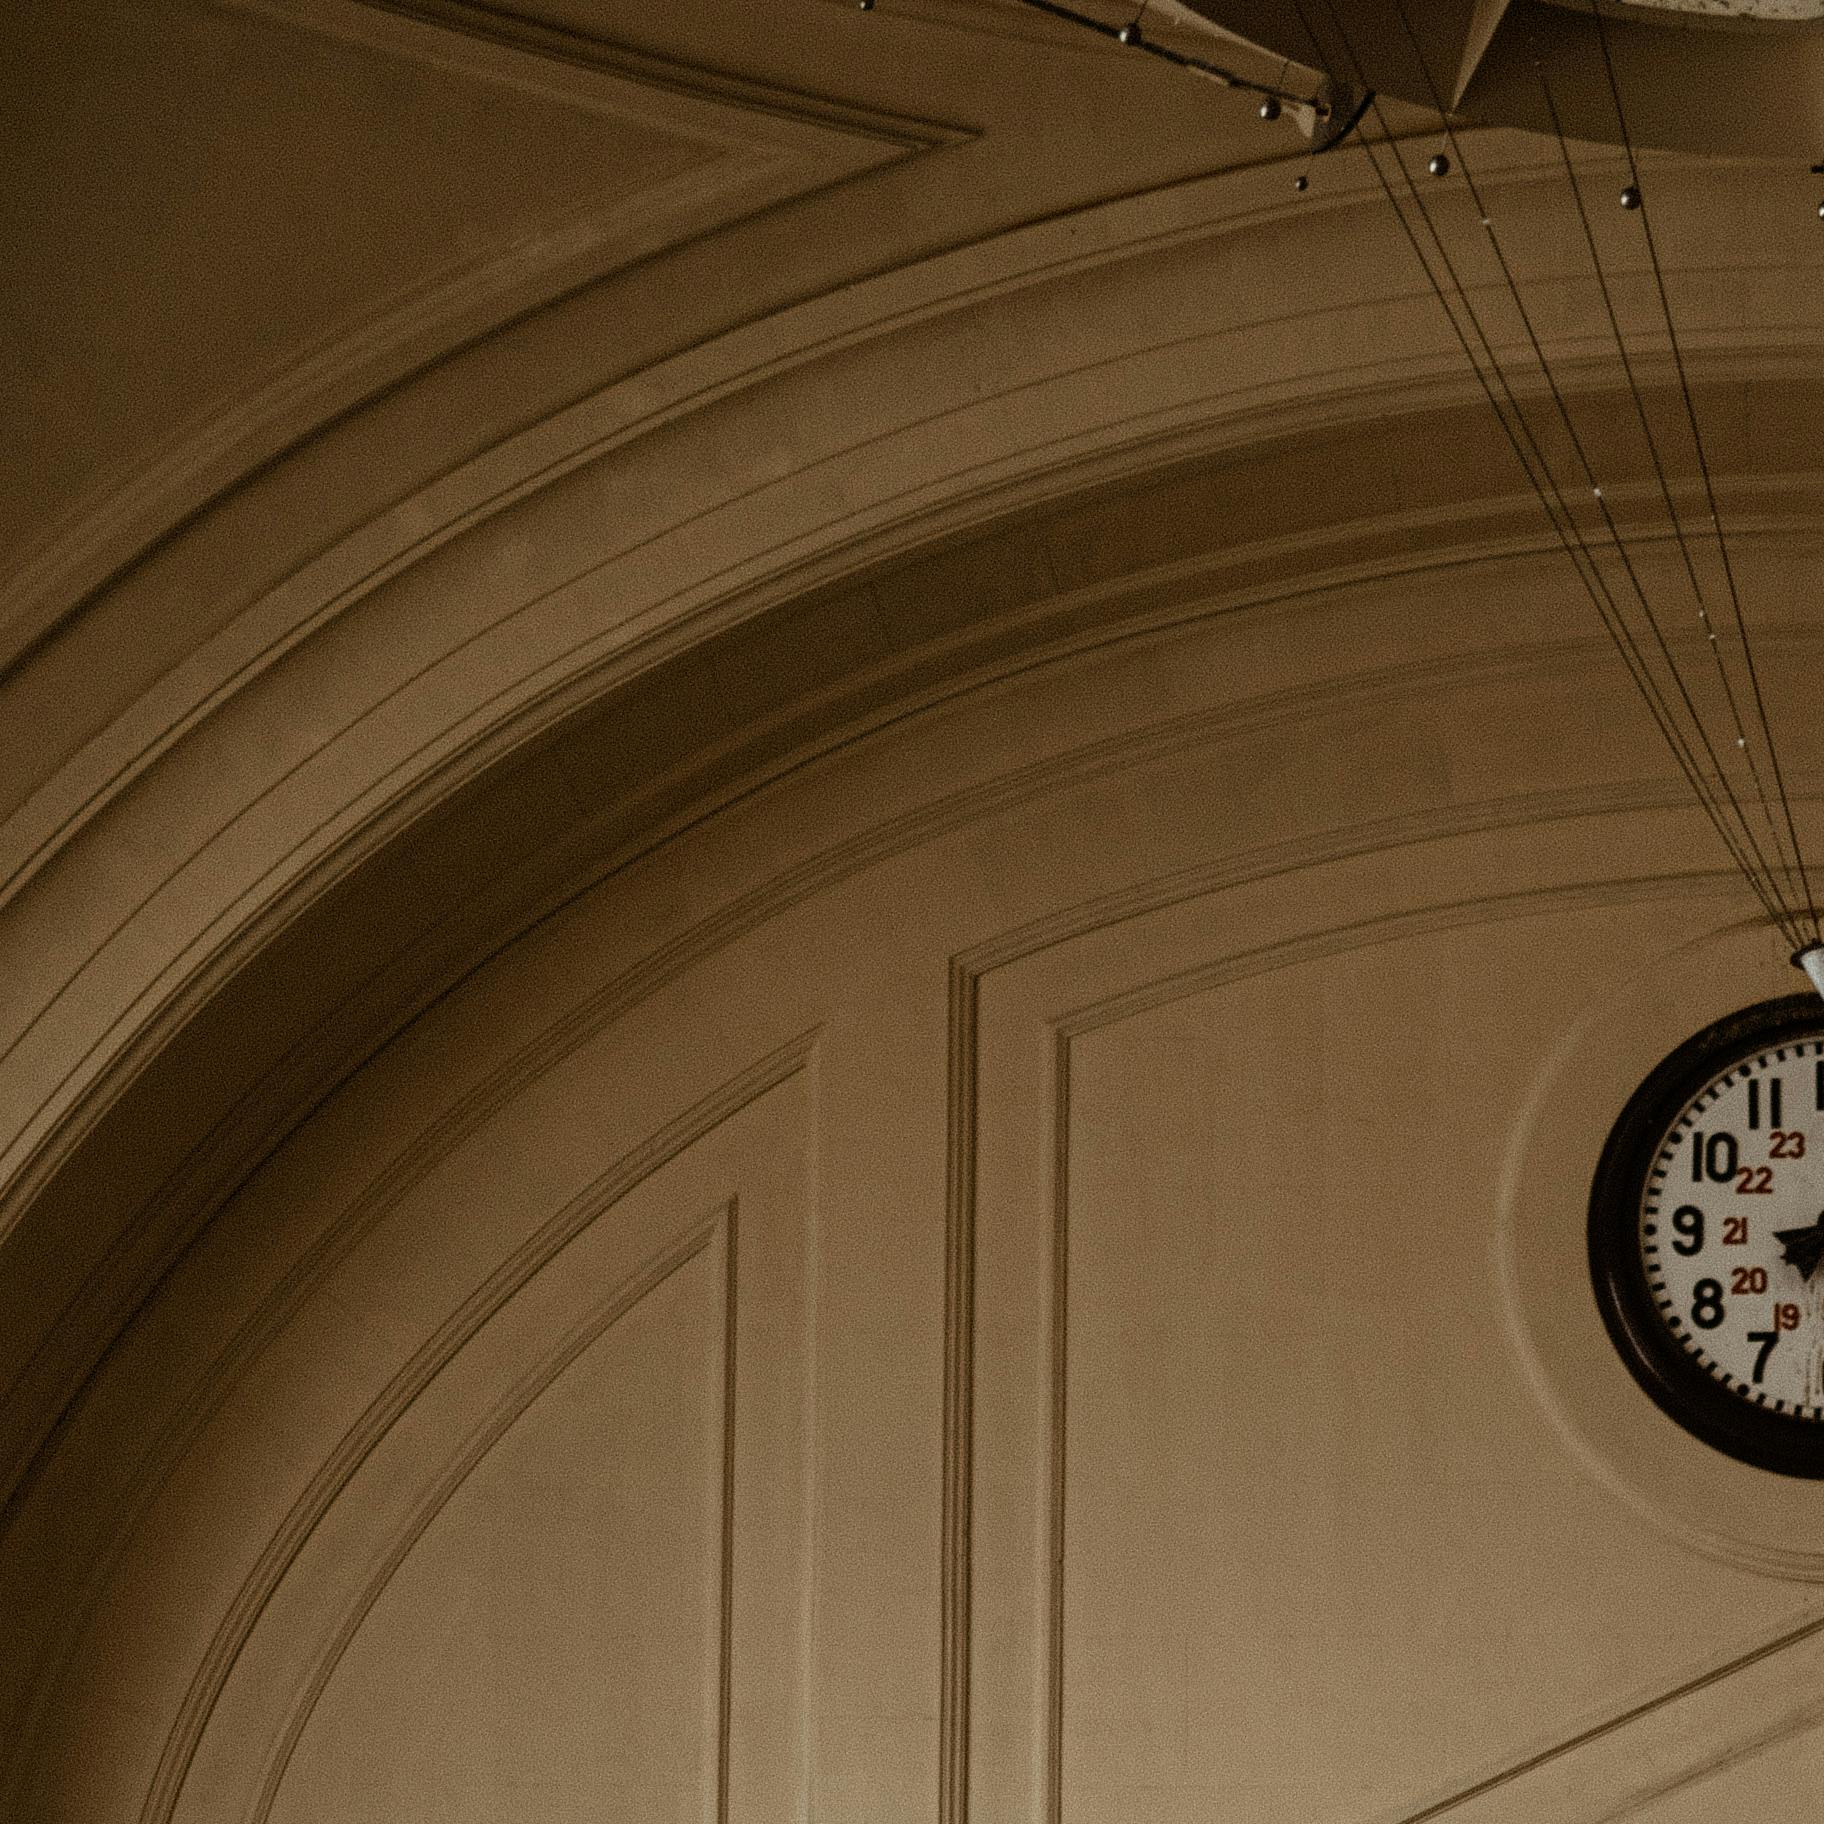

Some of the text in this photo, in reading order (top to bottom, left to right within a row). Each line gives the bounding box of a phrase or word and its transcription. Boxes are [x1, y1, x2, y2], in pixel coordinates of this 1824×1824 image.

[1748, 1078, 1782, 1129] 11
[1692, 1132, 1738, 1183] 10
[1769, 1132, 1805, 1159] 23
[1735, 1168, 1774, 1195] 22
[1672, 1206, 1704, 1257] 9
[1722, 1217, 1748, 1246] 21
[1731, 1267, 1768, 1295] 20
[1691, 1278, 1725, 1330] 8
[1774, 1303, 1800, 1330] 19
[1746, 1332, 1778, 1384] 7
